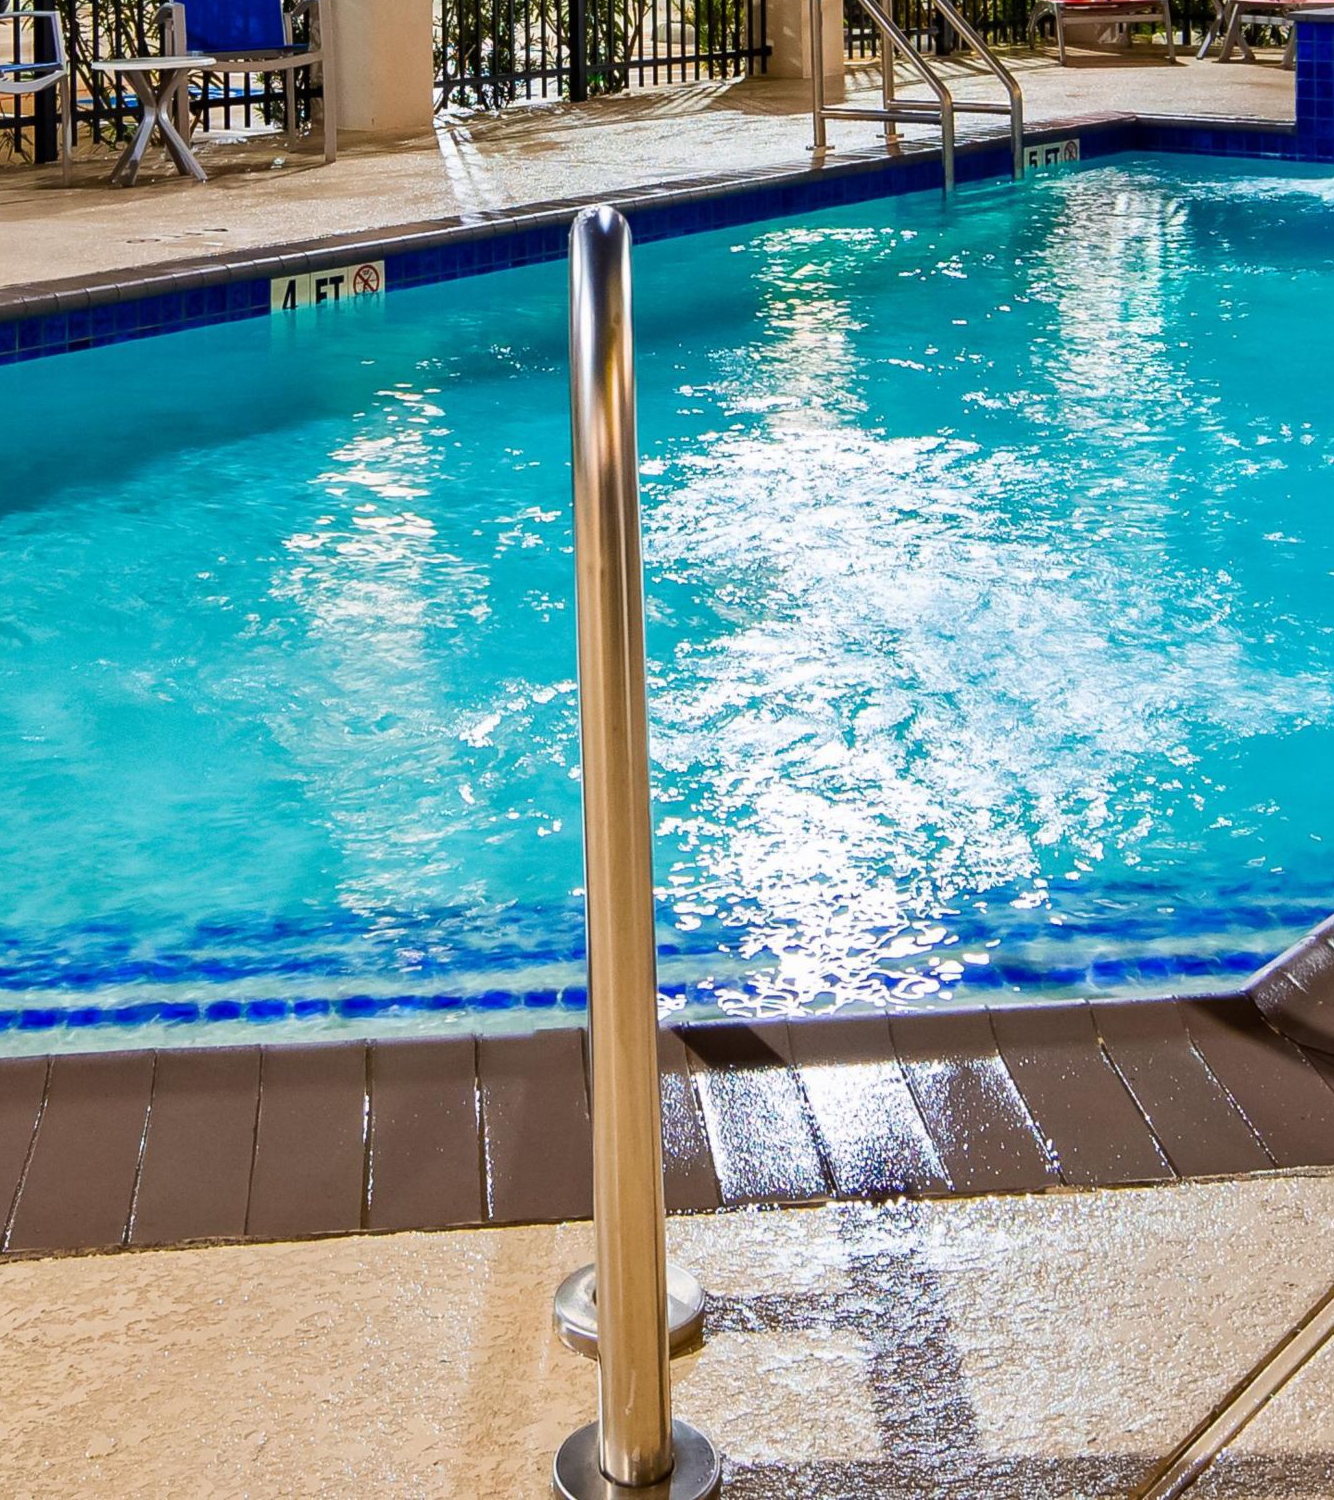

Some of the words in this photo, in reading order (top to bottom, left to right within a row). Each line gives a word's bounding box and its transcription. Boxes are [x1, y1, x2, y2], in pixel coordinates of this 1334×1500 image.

[1045, 147, 1060, 168] FT
[282, 279, 299, 310] 4
[315, 275, 344, 304] FT
